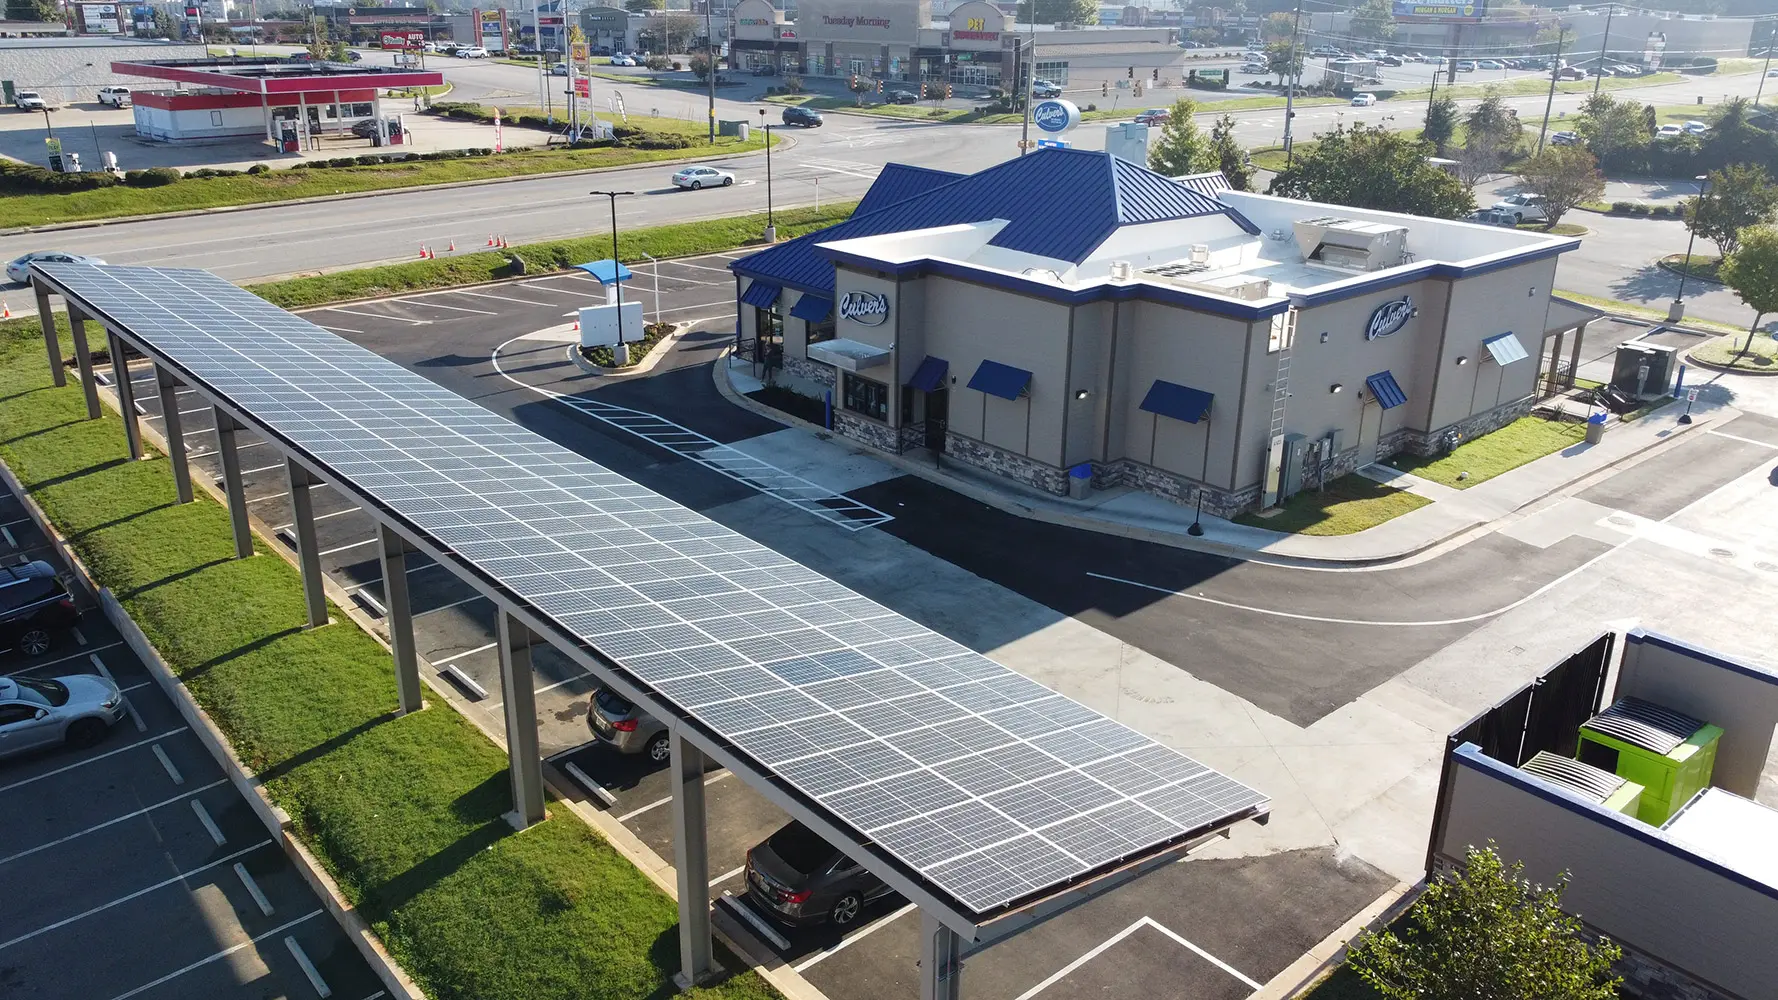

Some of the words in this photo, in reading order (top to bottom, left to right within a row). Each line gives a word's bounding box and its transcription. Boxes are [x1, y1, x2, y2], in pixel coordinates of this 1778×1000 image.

[823, 15, 854, 28] Tuesday
[855, 16, 890, 29] Morning
[967, 17, 985, 31] PET
[1035, 106, 1064, 123] Culver's
[839, 292, 887, 319] Culver's
[1368, 296, 1412, 341] Culver's
